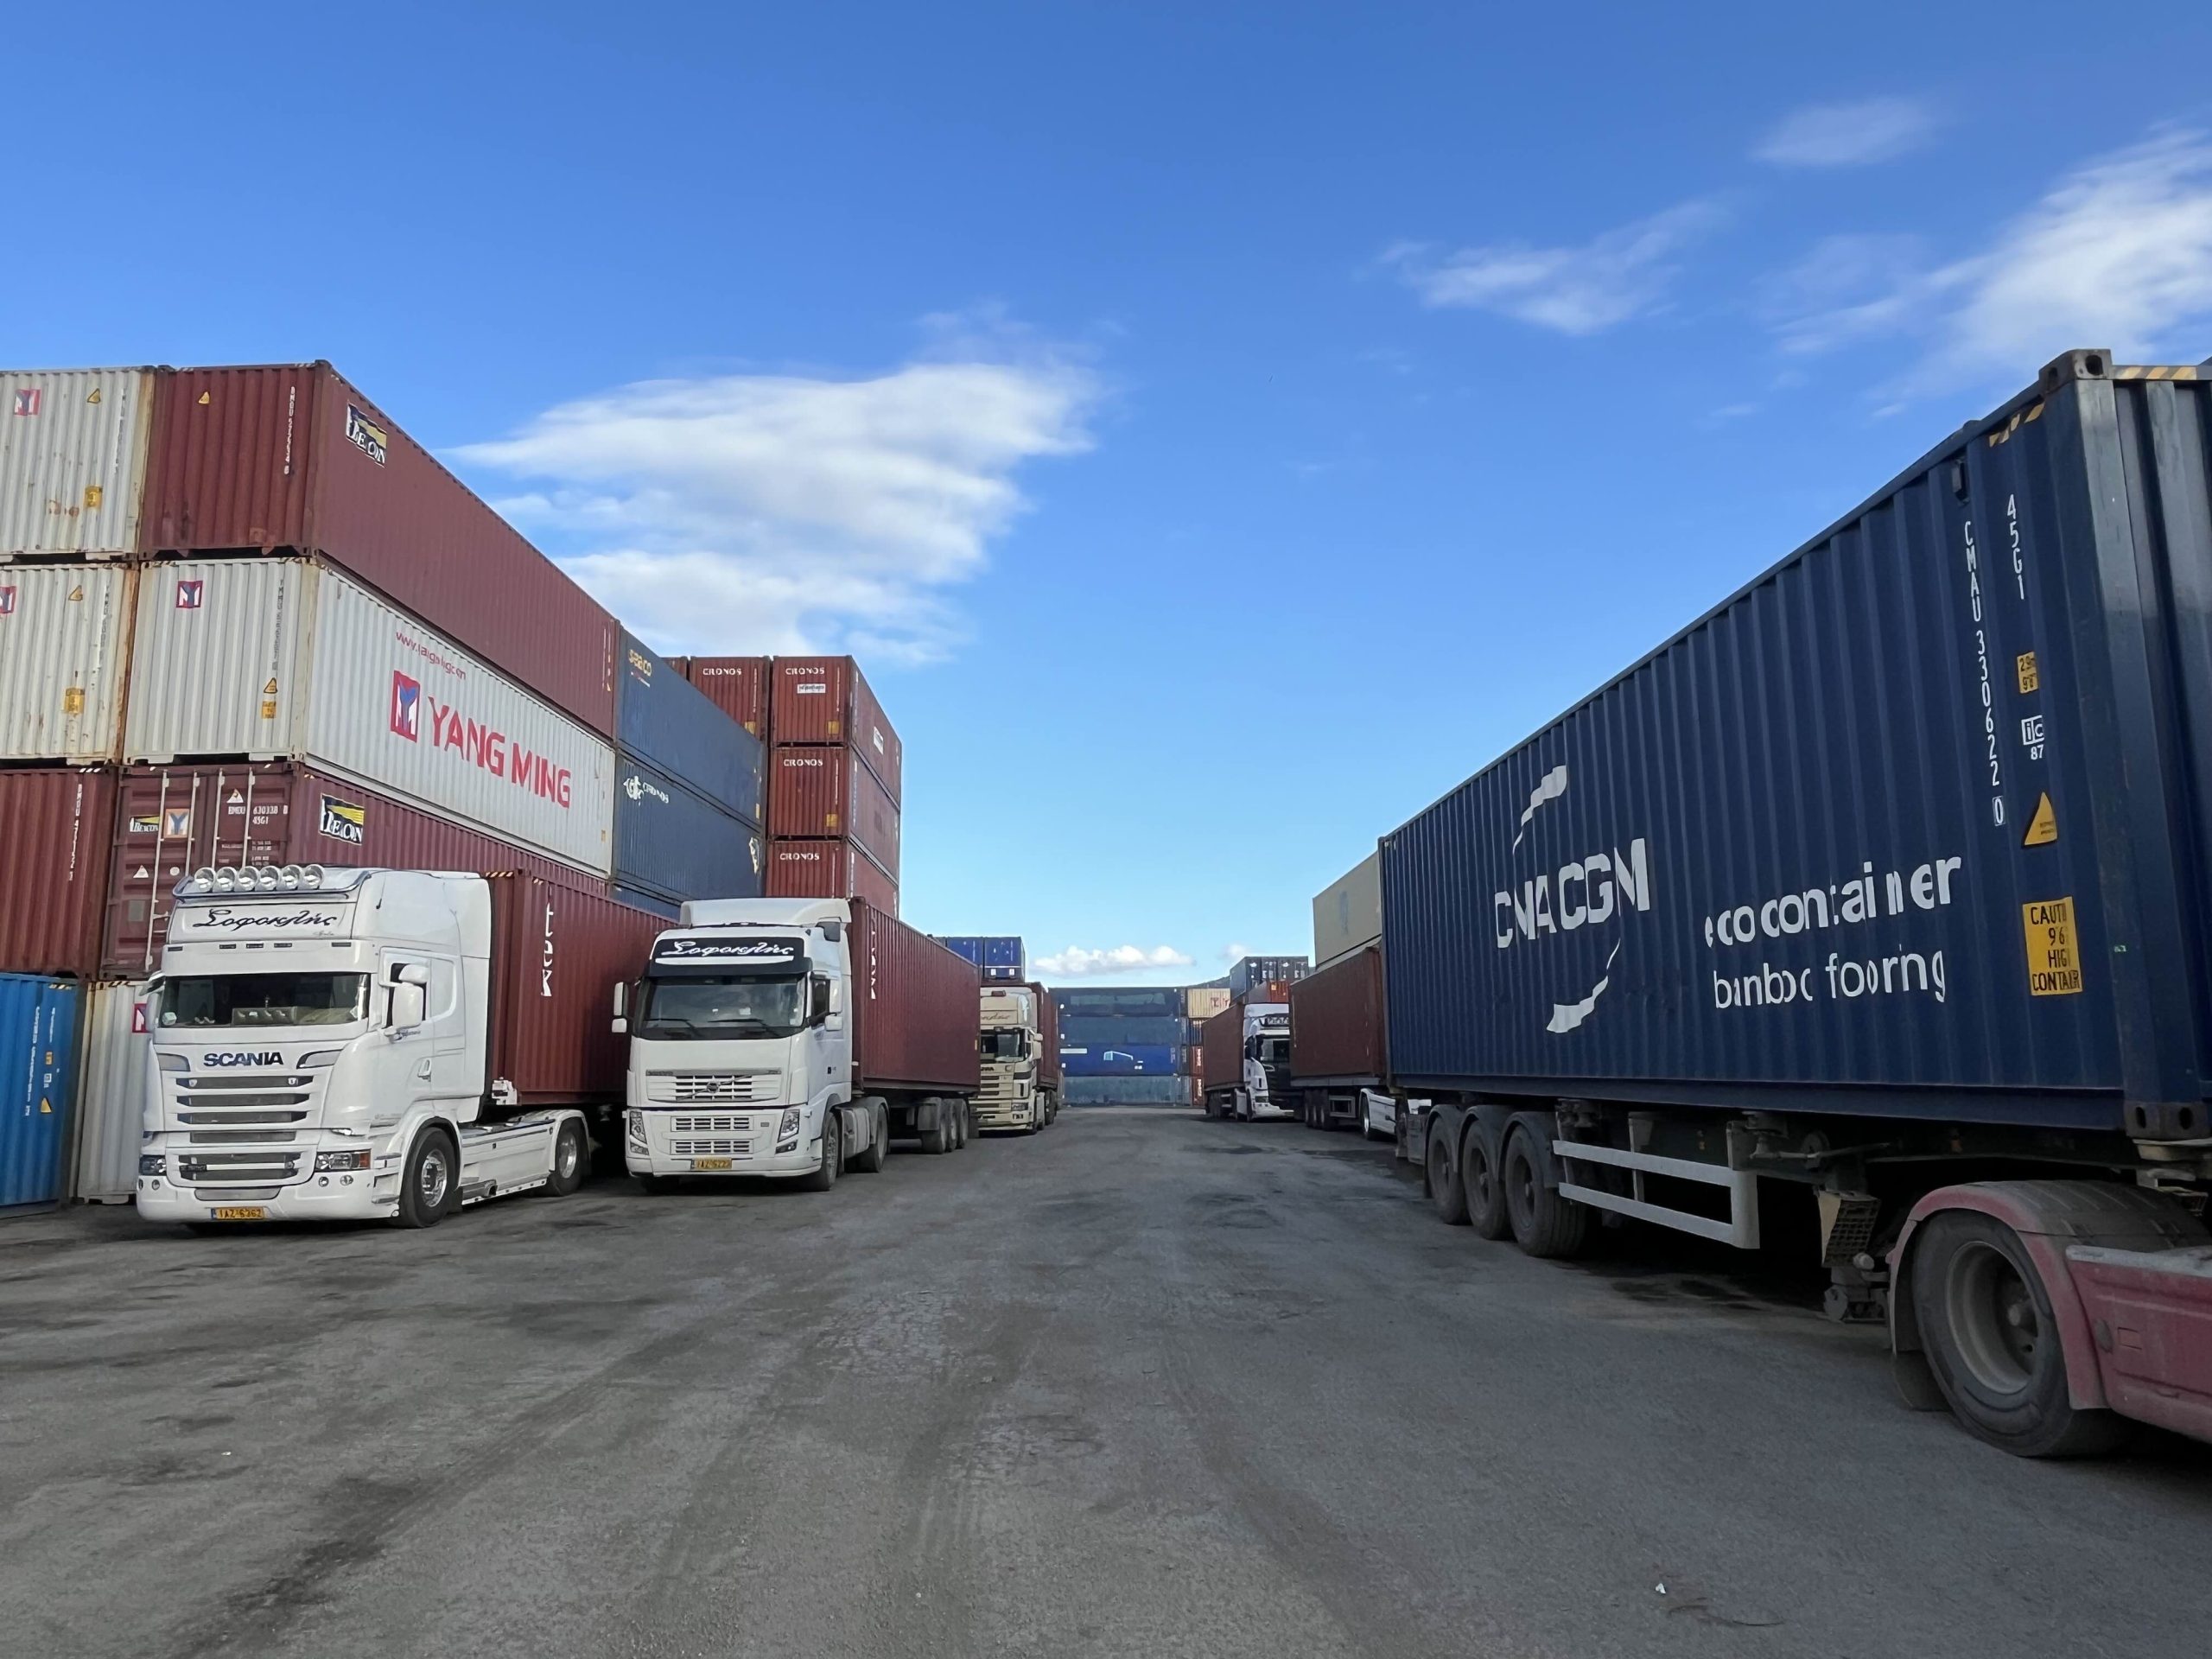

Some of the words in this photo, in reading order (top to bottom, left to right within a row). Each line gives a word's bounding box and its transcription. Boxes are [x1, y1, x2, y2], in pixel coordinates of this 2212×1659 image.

[1964, 520, 1981, 622] CMAU
[1975, 629, 2000, 787] 330622
[1993, 797, 2005, 825] 0
[428, 696, 505, 777] YANG
[512, 742, 571, 809] MING
[2031, 744, 2044, 760] 87
[203, 1052, 284, 1068] SCANIA
